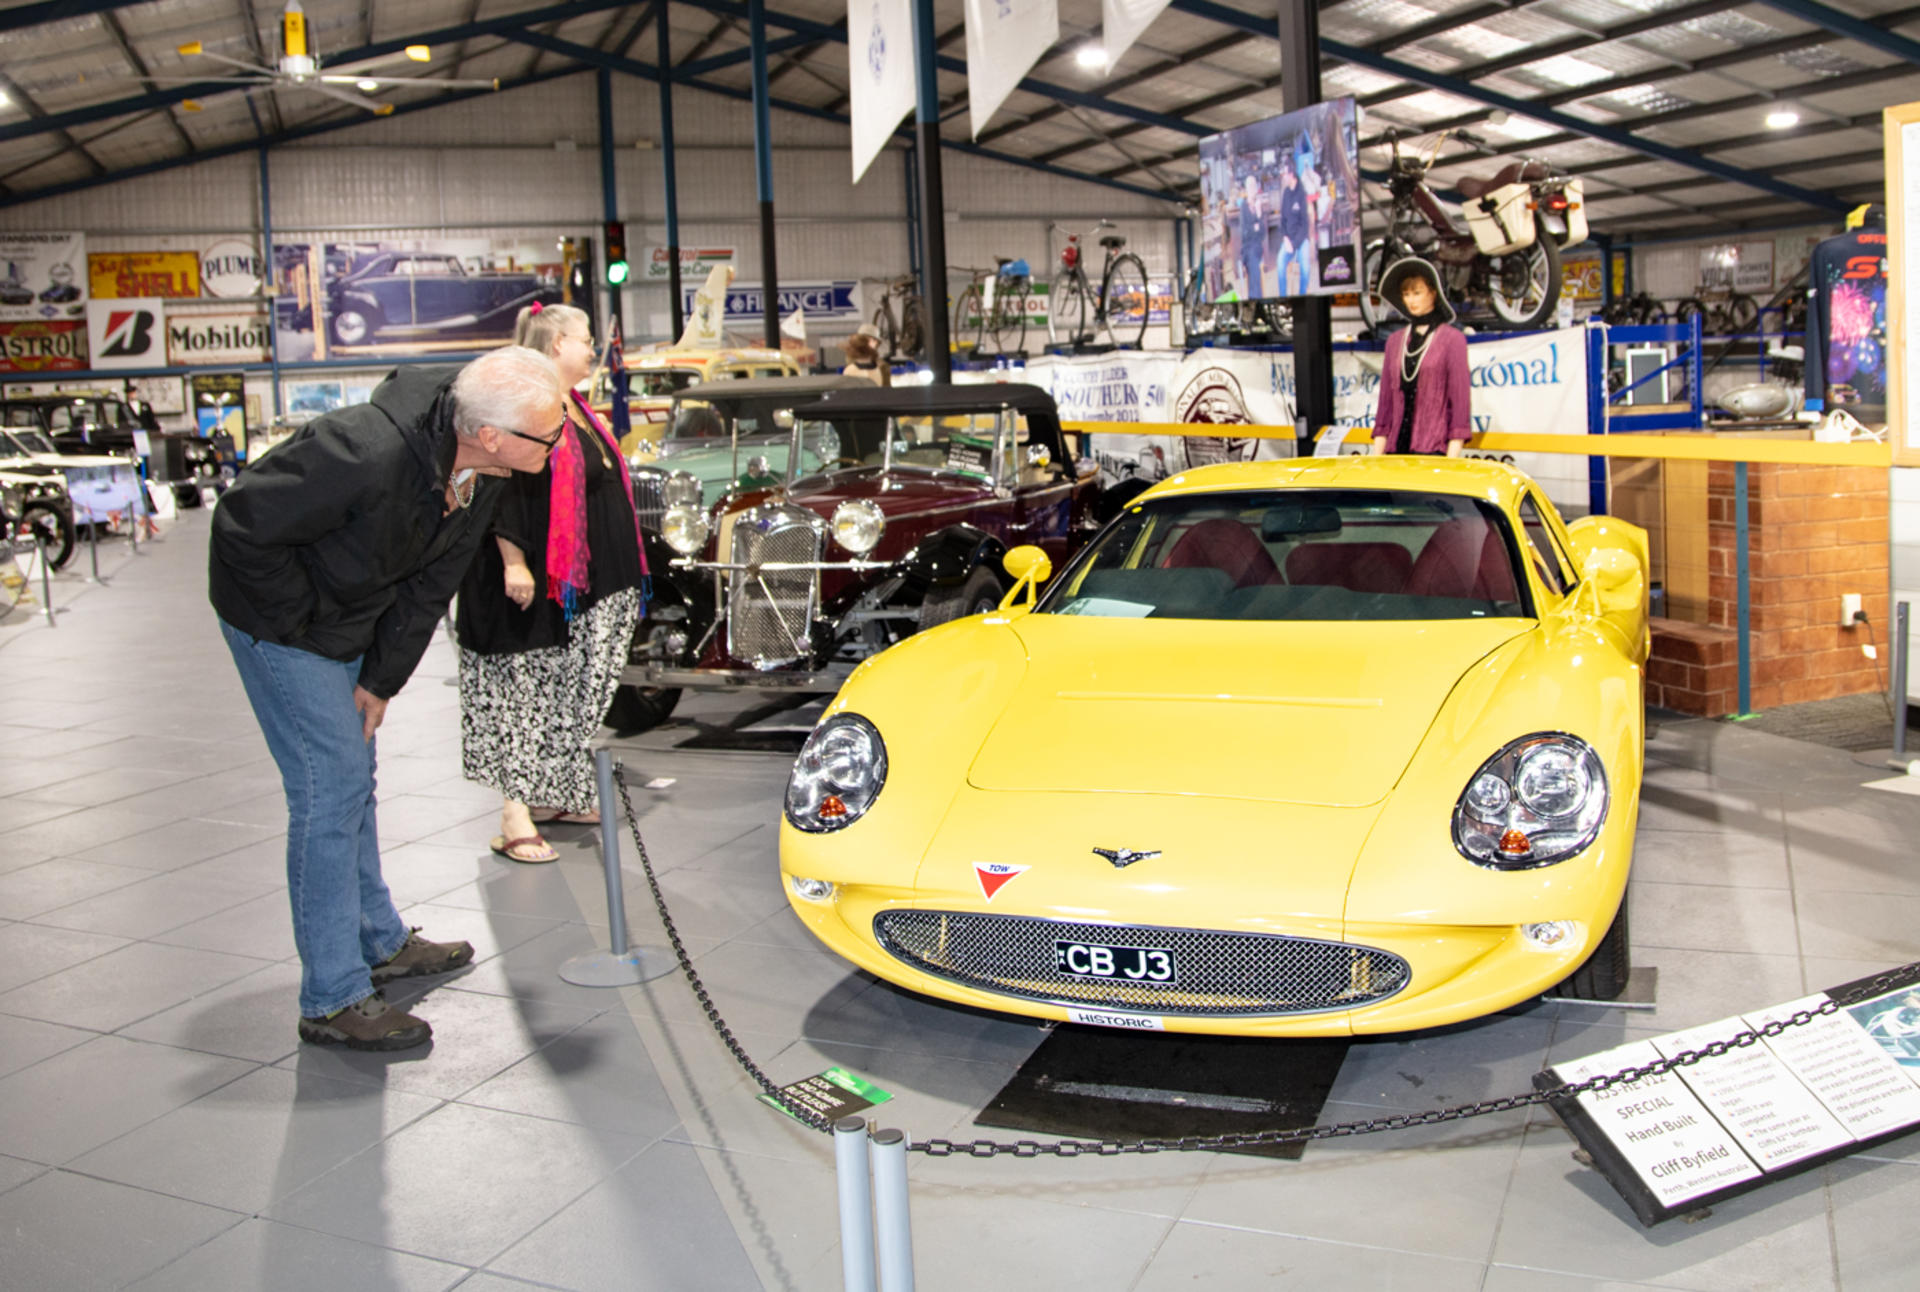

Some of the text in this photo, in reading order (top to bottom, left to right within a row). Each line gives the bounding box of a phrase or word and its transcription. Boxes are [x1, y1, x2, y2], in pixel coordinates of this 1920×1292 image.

[0, 235, 48, 243] TANDARD
[205, 256, 263, 280] PLUME
[116, 272, 195, 298] SHELL
[747, 292, 827, 312] FIANCE
[171, 323, 271, 351] Mobiloil
[988, 864, 1011, 873] TOW
[1066, 944, 1173, 981] CB J3
[1078, 1012, 1154, 1028] HISTORIC
[1616, 1095, 1674, 1119] SPECIAL
[1625, 1113, 1698, 1142] Hand Built
[1649, 1144, 1731, 1177] Cliff Byfield
[1717, 1162, 1748, 1176] Australia
